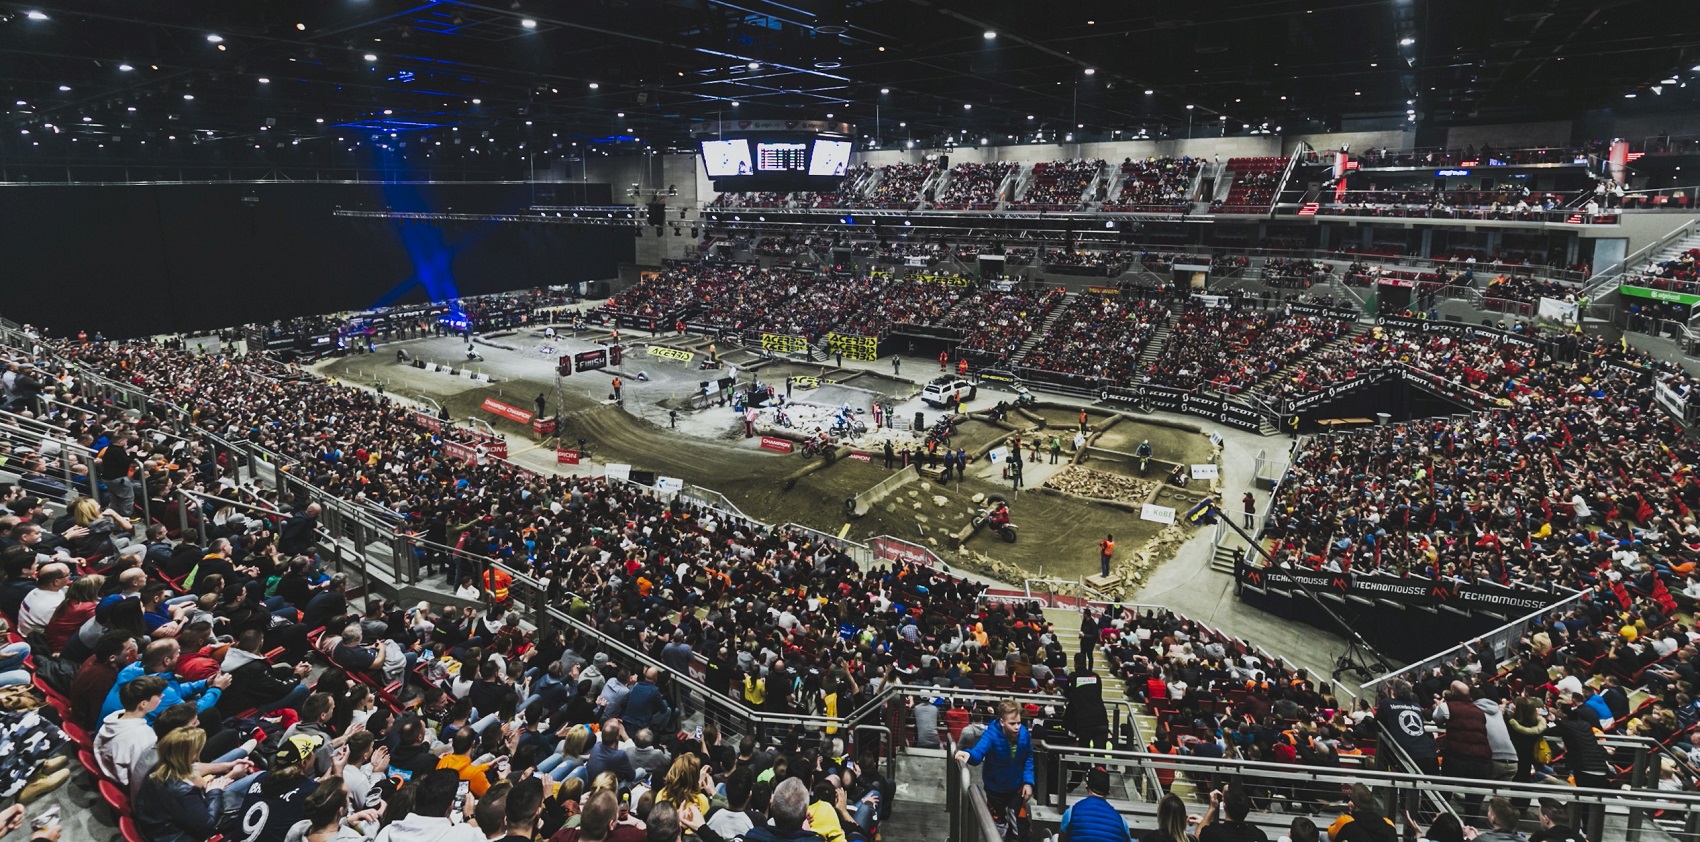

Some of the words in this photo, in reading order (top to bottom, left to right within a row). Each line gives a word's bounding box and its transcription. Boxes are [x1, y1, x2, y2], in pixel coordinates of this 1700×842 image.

[389, 310, 426, 319] START
[1293, 306, 1319, 314] SCOTT
[1386, 319, 1419, 328] SCOTT
[764, 335, 806, 347] ACERBIS
[830, 334, 876, 347] ACERBIS
[1474, 330, 1501, 341] SCOTT
[651, 347, 691, 361] ACERBIS
[830, 342, 876, 354] ACERBIS
[579, 357, 605, 368] FINISH
[1407, 373, 1429, 385] SCOTT
[1336, 378, 1366, 393] SCOTT
[1108, 393, 1139, 403] SCOTT
[1189, 395, 1219, 407] SCOTT
[1296, 392, 1326, 407] SCOTT
[484, 399, 508, 411] CHAMPION
[507, 407, 531, 419] CHAMPION
[1187, 405, 1217, 418] SCOTT
[1228, 405, 1259, 418] SCOTT
[1226, 416, 1259, 429] SCOTT
[762, 438, 791, 448] CHAMPION
[1153, 508, 1173, 518] KoBE
[1267, 573, 1329, 586] TECHMOUSSE
[1356, 580, 1427, 597] TECHNOMOUSSE
[1459, 590, 1547, 609] TECHNOMOUSSE
[242, 801, 270, 842] 9
